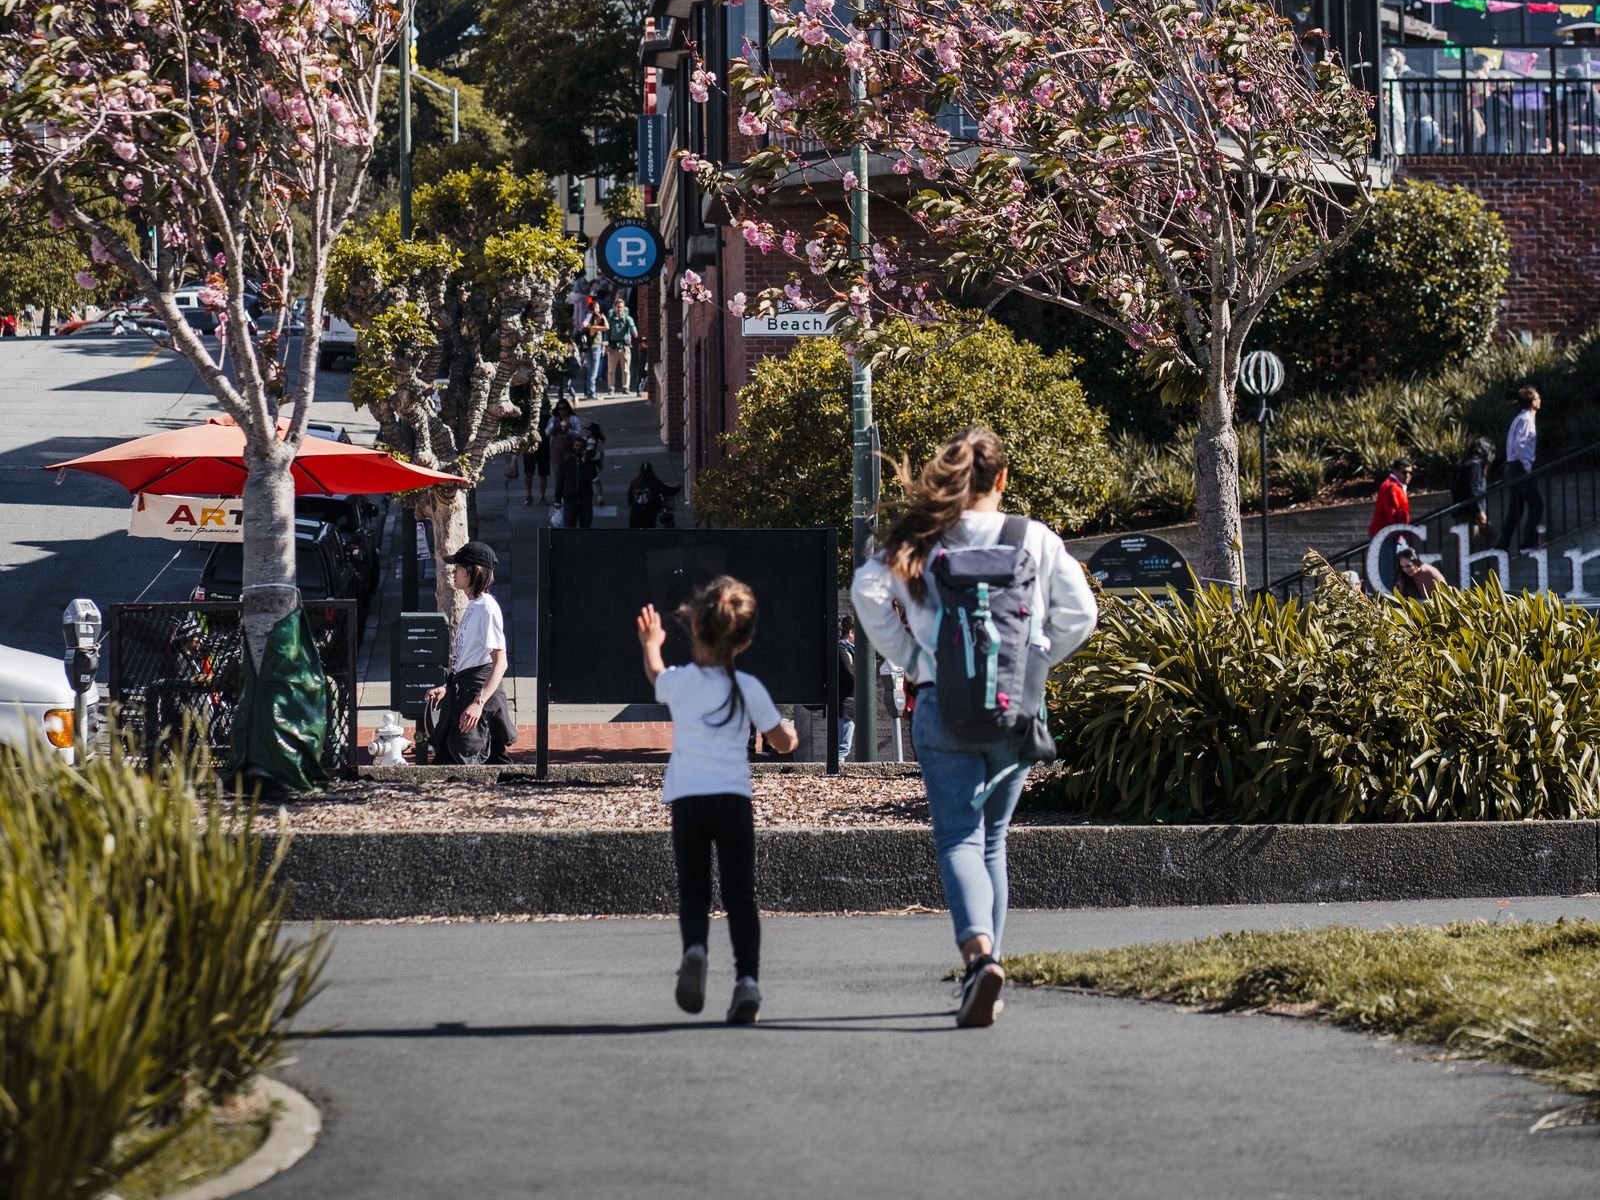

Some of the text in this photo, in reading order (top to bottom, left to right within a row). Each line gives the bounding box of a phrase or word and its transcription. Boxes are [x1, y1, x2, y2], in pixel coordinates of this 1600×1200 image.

[614, 220, 648, 228] PUBLIC
[617, 237, 647, 267] P
[613, 274, 650, 285] PARKING
[767, 318, 822, 331] Beach
